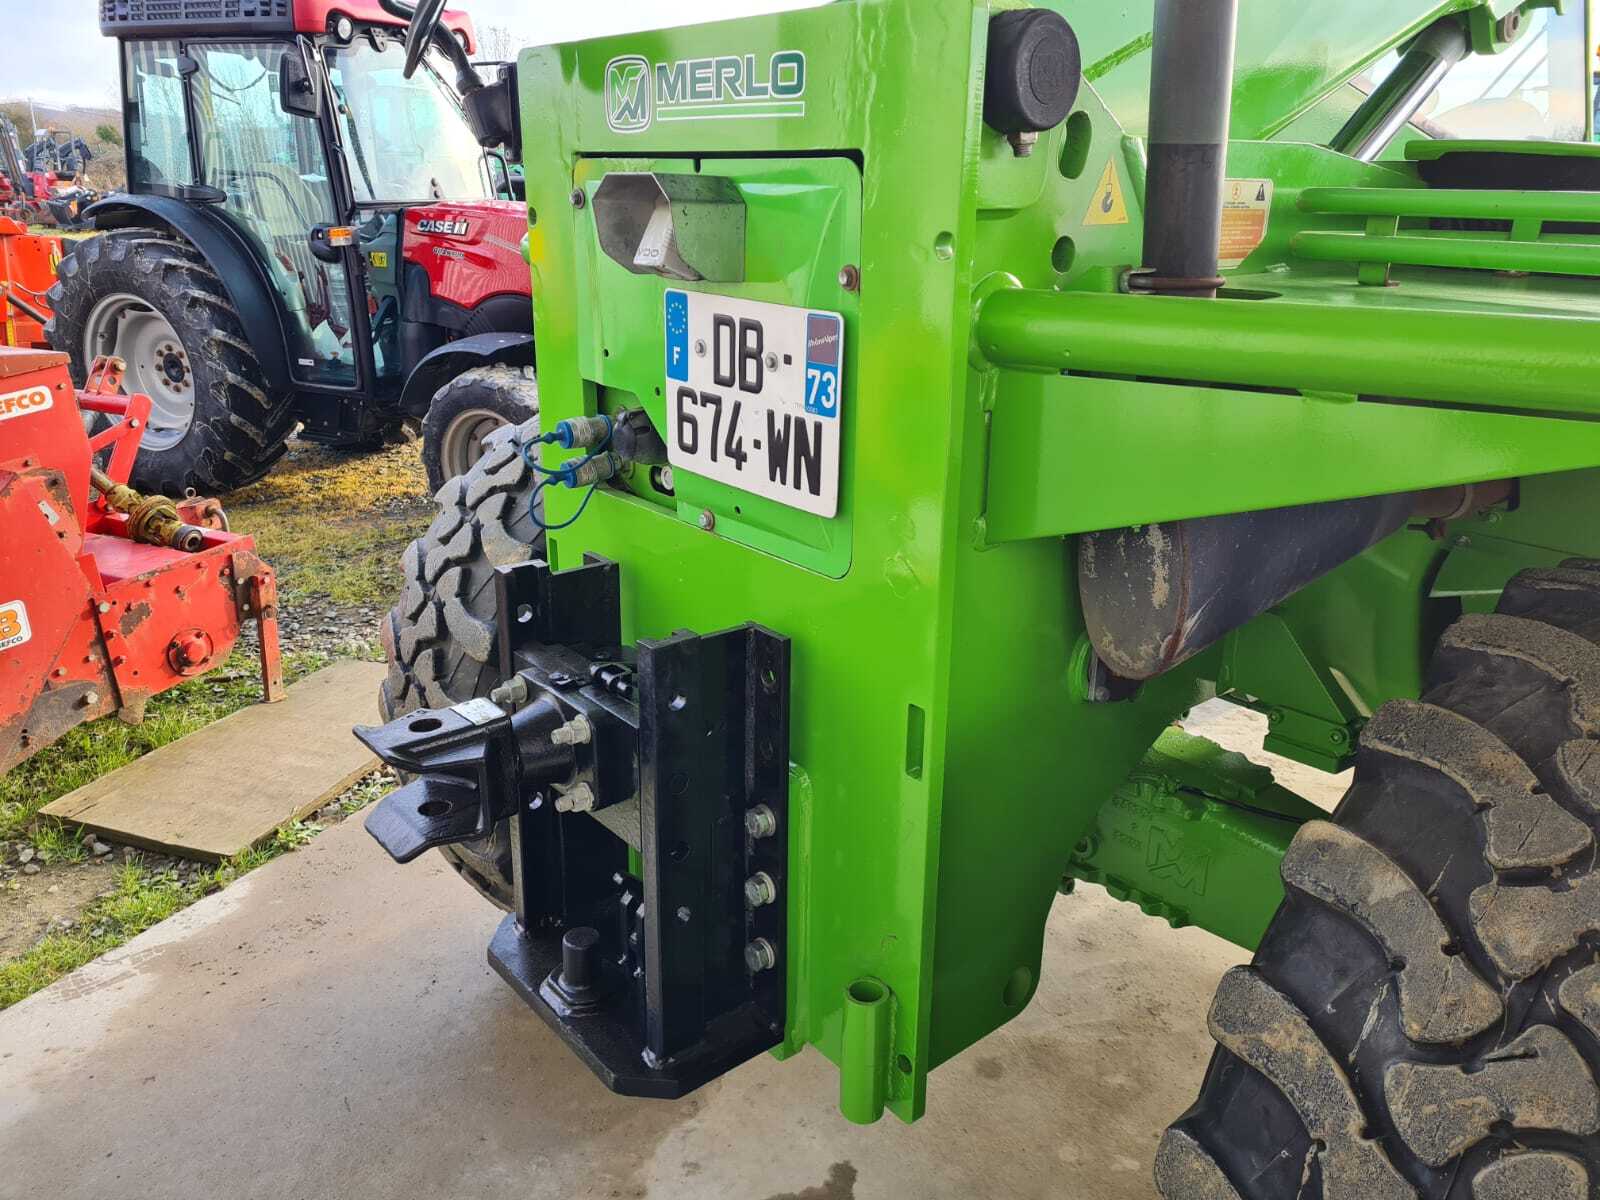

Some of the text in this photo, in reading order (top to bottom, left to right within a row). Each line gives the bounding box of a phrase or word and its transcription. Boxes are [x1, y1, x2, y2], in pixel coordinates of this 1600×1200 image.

[656, 51, 805, 104] MERLO
[416, 219, 453, 234] CASE
[673, 346, 681, 366] F
[807, 369, 836, 409] 73
[677, 386, 822, 496] 674-WN
